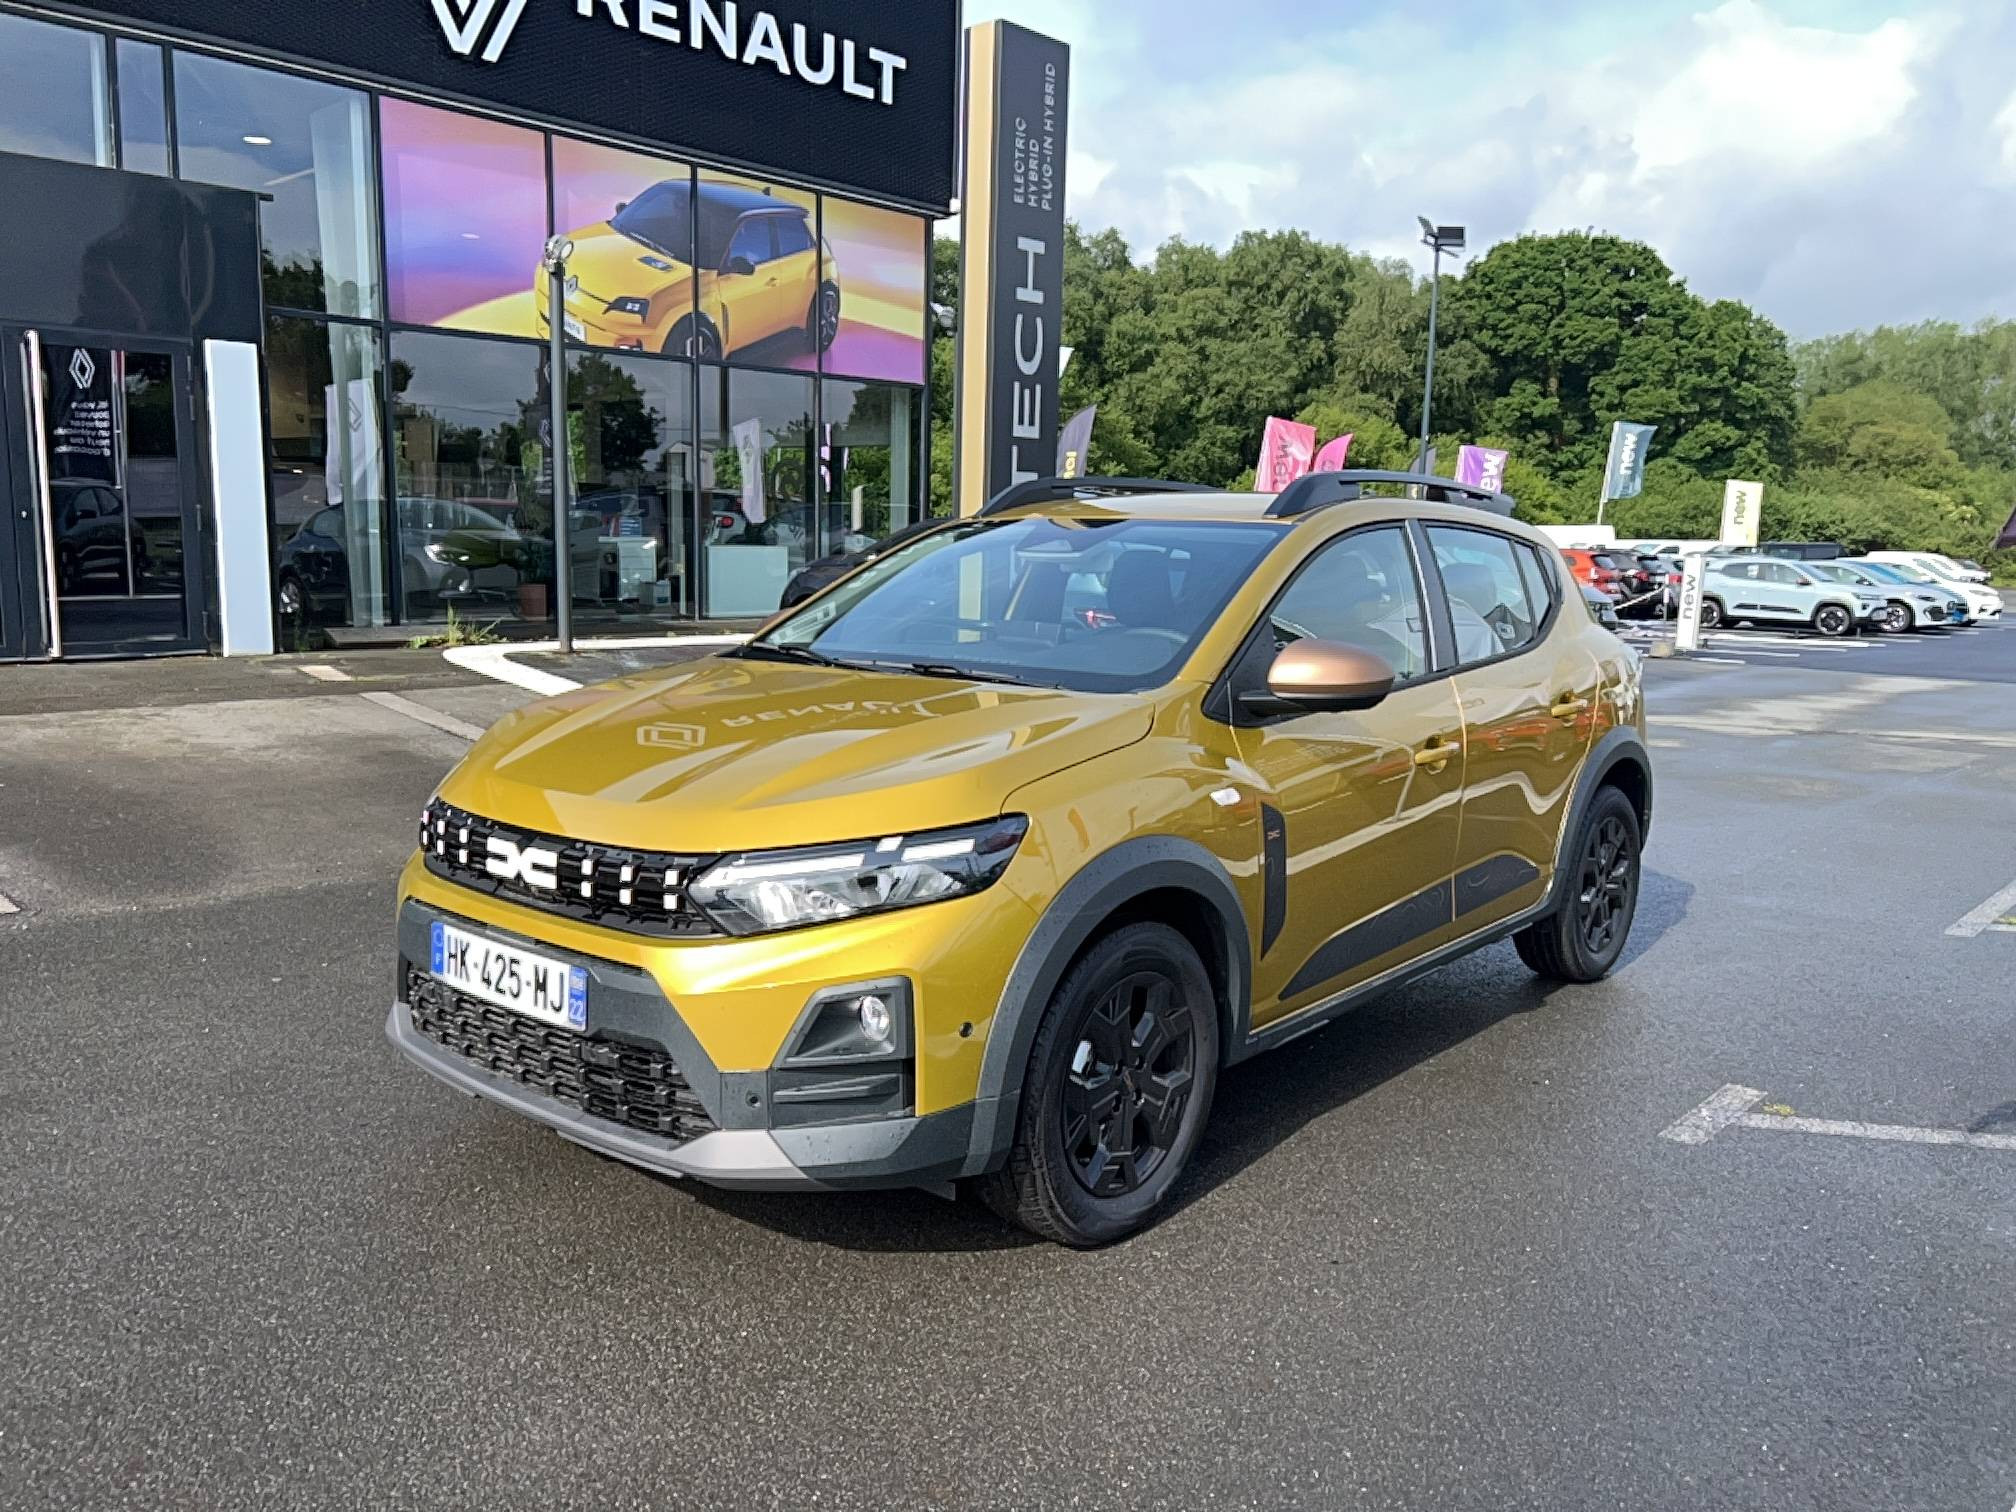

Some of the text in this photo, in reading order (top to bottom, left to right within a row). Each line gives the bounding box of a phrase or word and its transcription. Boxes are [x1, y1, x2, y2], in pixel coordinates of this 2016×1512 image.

[1013, 117, 1027, 204] ELECTRIC
[1041, 62, 1056, 211] PLUG-IN HYBRID
[1028, 138, 1040, 208] HYBRID
[1619, 431, 1638, 475] new
[1733, 490, 1748, 525] new
[1682, 574, 1697, 620] new
[446, 934, 564, 1012] HK-425-MJ
